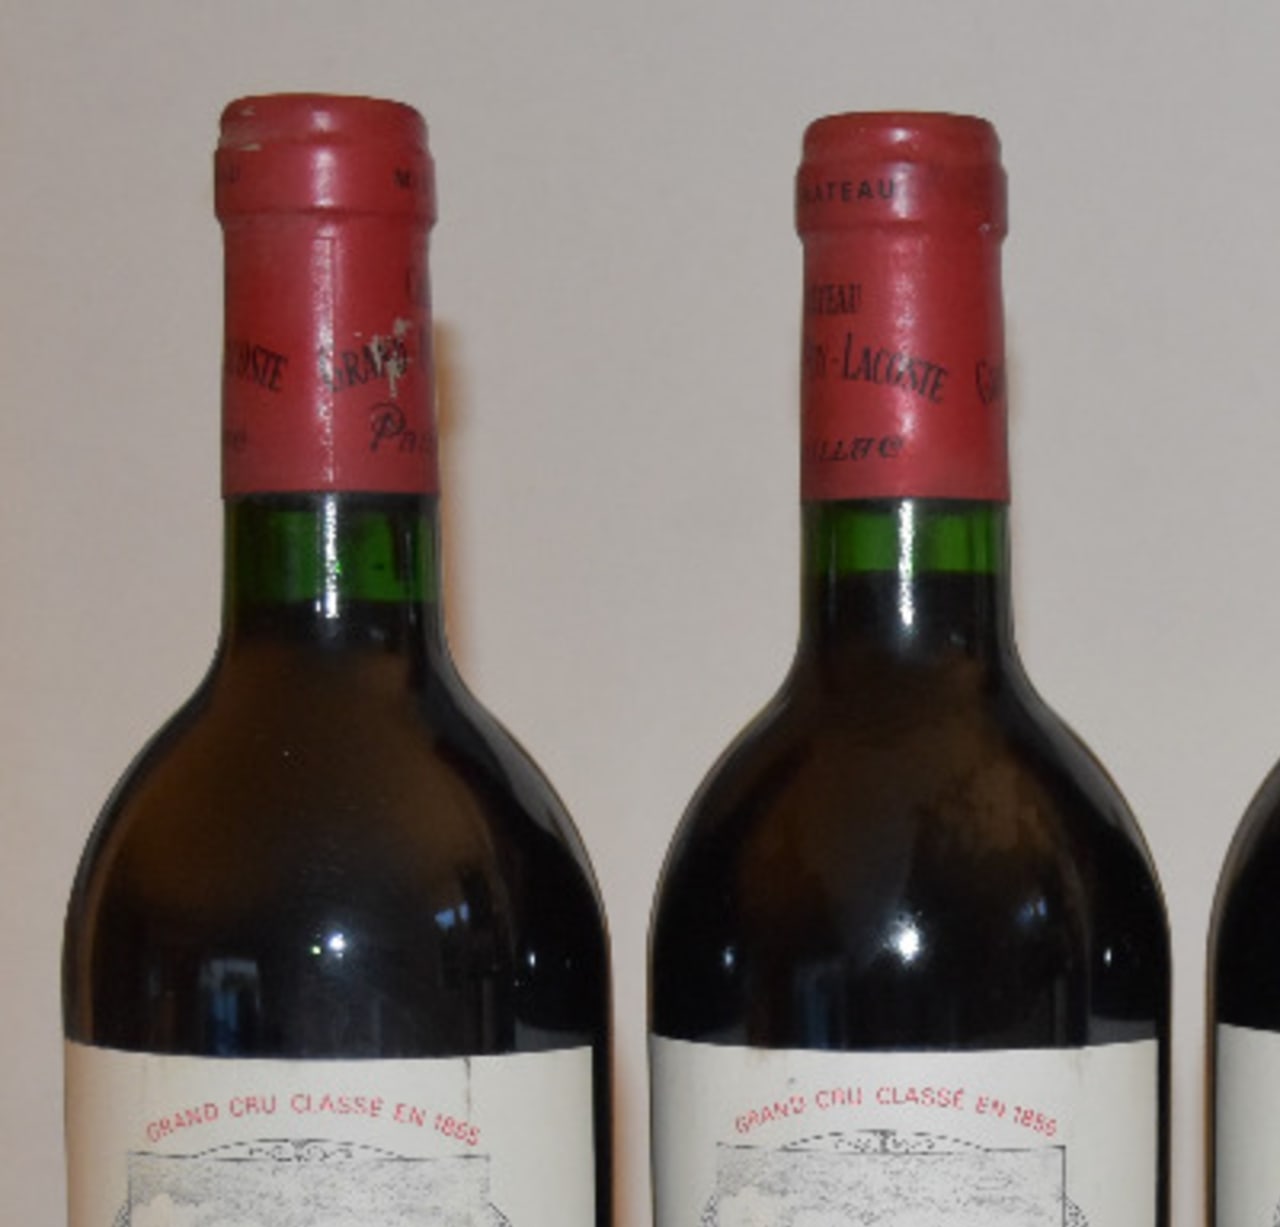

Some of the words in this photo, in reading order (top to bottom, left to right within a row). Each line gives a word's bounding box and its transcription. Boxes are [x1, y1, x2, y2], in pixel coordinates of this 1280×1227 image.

[146, 1103, 219, 1144] GRAND
[229, 1094, 277, 1118] CRU
[393, 1104, 425, 1128] EN
[735, 1095, 805, 1134] GRAND
[815, 1087, 863, 1110] CRU
[975, 1095, 1006, 1119] EN
